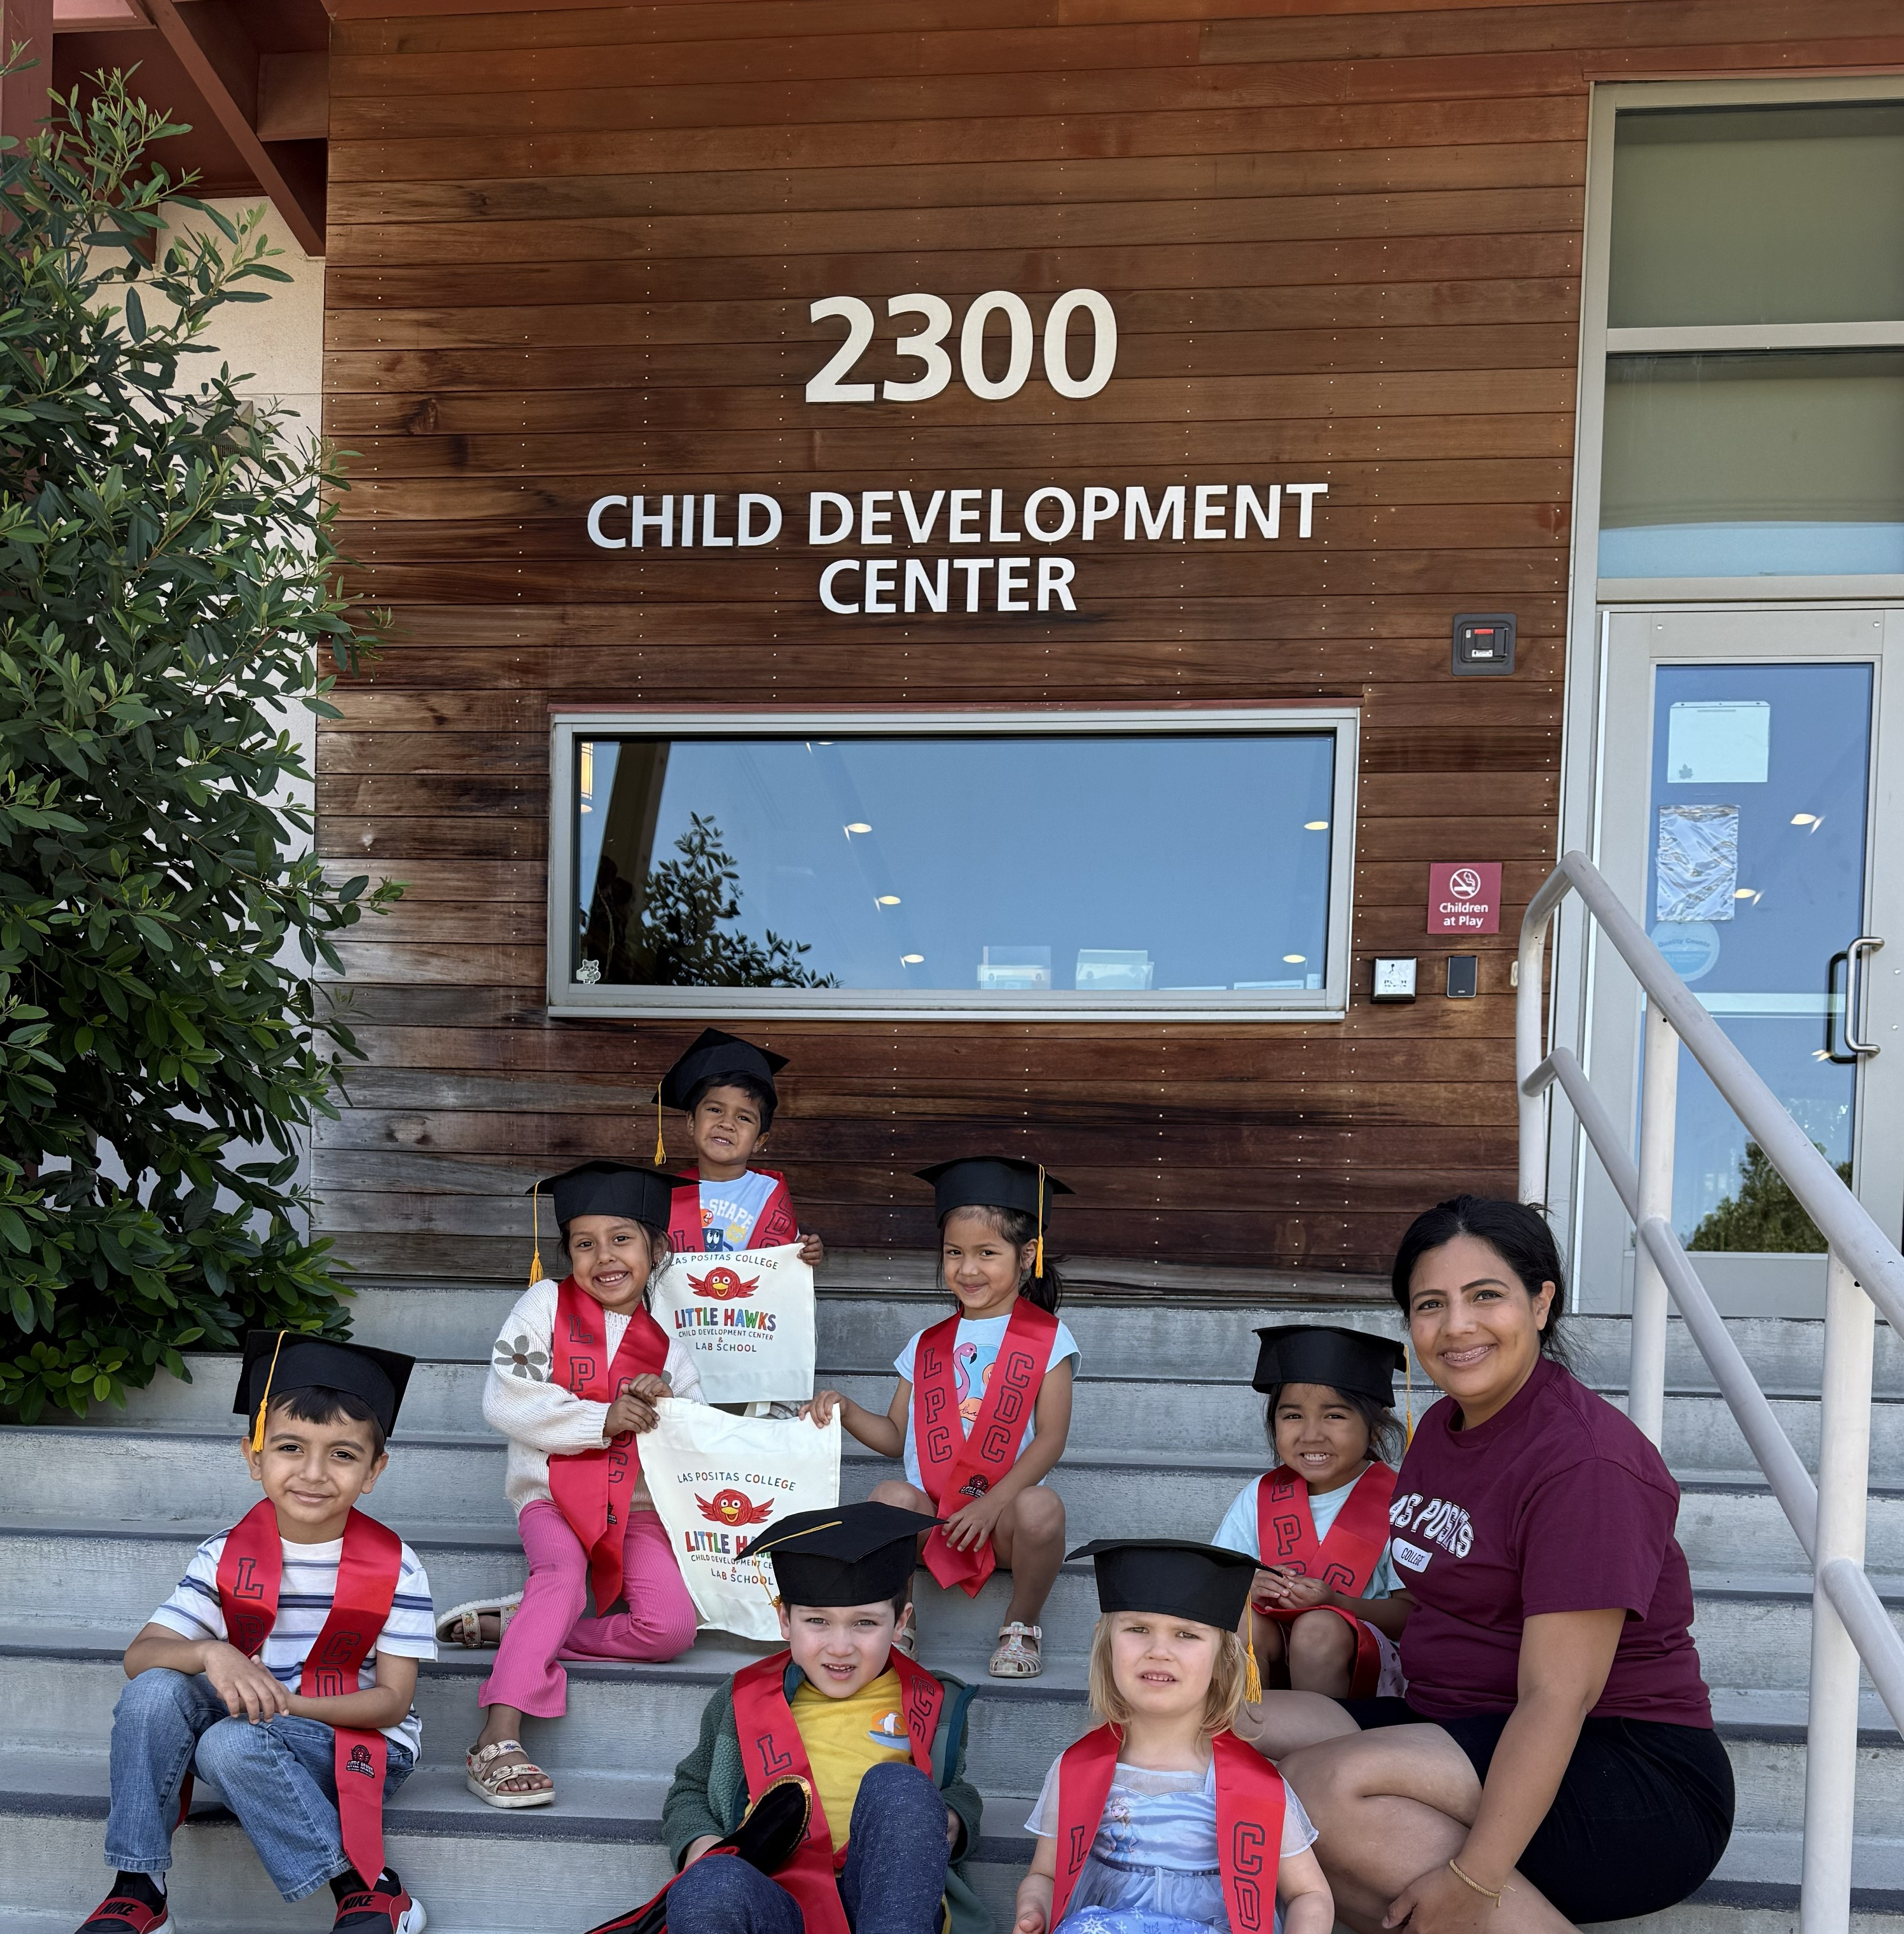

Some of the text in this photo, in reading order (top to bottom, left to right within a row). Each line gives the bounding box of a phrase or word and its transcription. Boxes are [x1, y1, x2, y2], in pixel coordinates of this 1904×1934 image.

[805, 288, 1118, 403] 2300
[587, 483, 1328, 549] CHILD DEVELOPMENT
[819, 557, 1077, 614] CENTER
[1439, 902, 1489, 913] Children
[1443, 915, 1484, 928] at Play
[1658, 938, 1710, 947] Quality Counts
[691, 1253, 731, 1262] POSITAS
[736, 1254, 778, 1270] COLLEGE
[674, 1307, 777, 1332] LITTLE HAWKS
[679, 1328, 774, 1341] CHILD DEVELOPMENT CENTER
[695, 1342, 757, 1353] LAB SCHOOL
[923, 1347, 953, 1464] LPC
[981, 1352, 1035, 1463] CDC
[678, 1471, 797, 1491] LAS POSITAS COLLEGE
[685, 1530, 730, 1554] LITTLE
[711, 1568, 774, 1585] LAB SCHOOL
[98, 1901, 140, 1917] NIKE
[340, 1894, 376, 1913] NIKE
